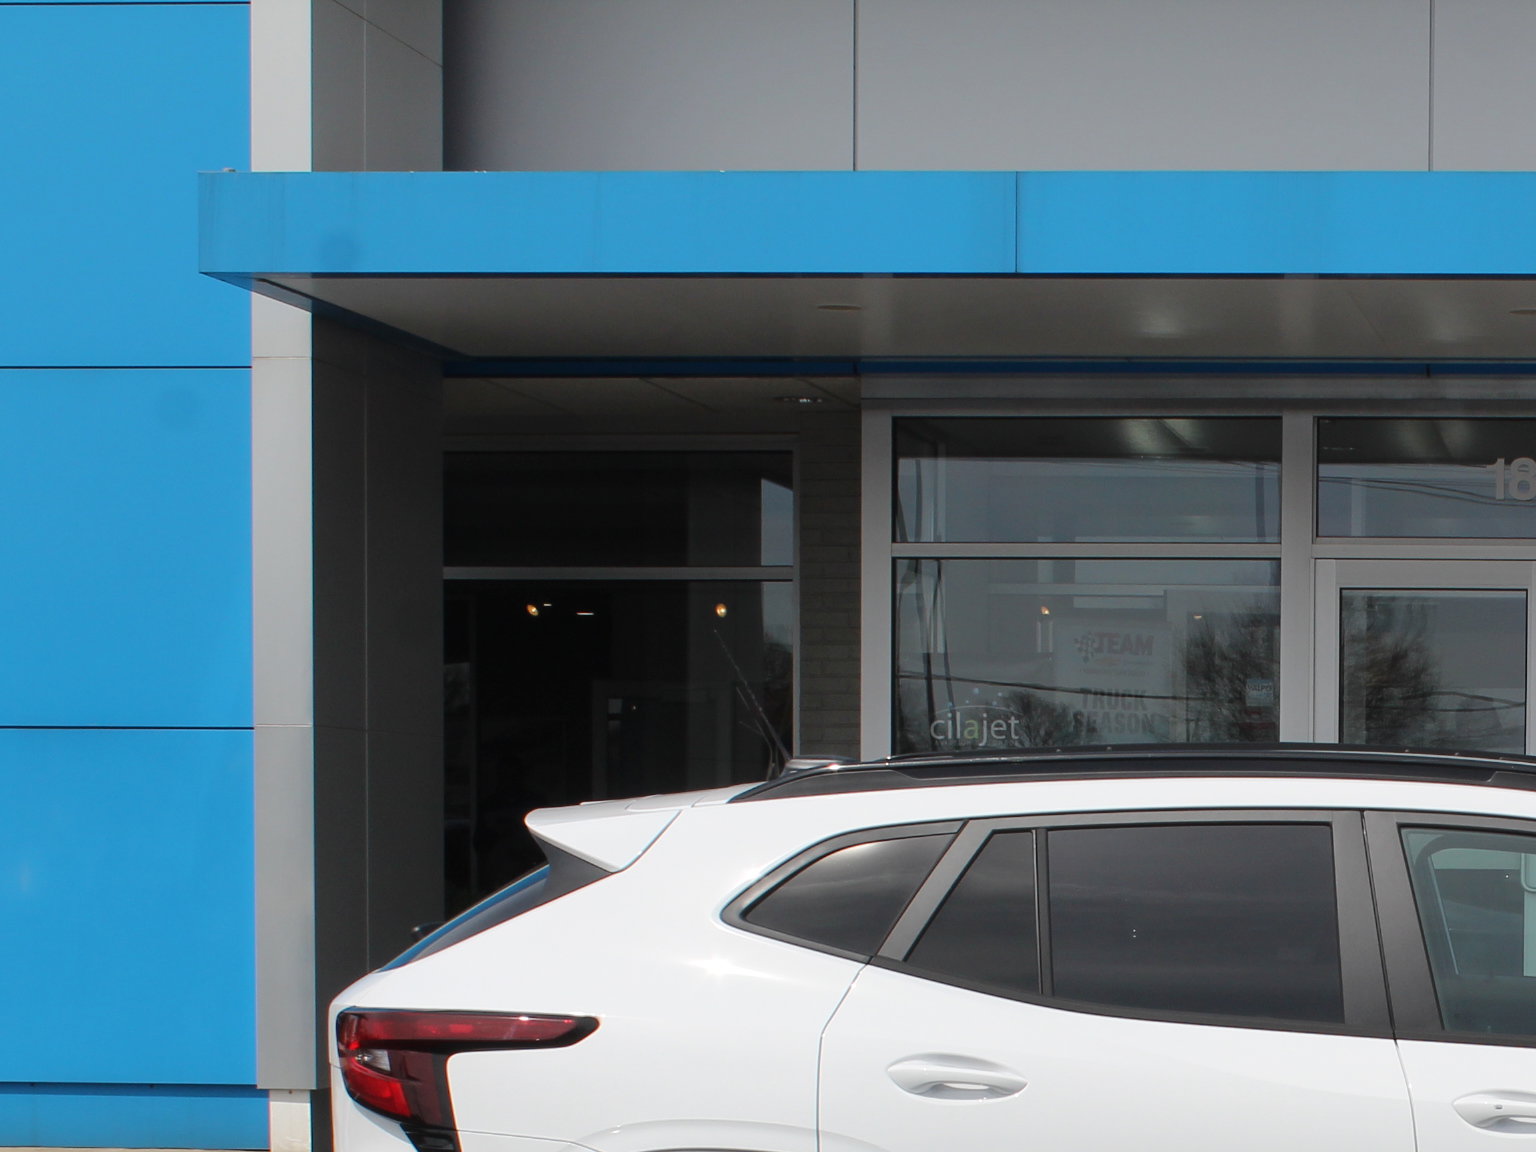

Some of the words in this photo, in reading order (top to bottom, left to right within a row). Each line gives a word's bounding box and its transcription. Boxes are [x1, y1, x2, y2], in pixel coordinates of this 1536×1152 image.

[1093, 632, 1155, 655] TEAM
[1080, 688, 1148, 711] TRUCK
[930, 711, 1020, 747] cilajet
[1073, 711, 1157, 735] SEASON
